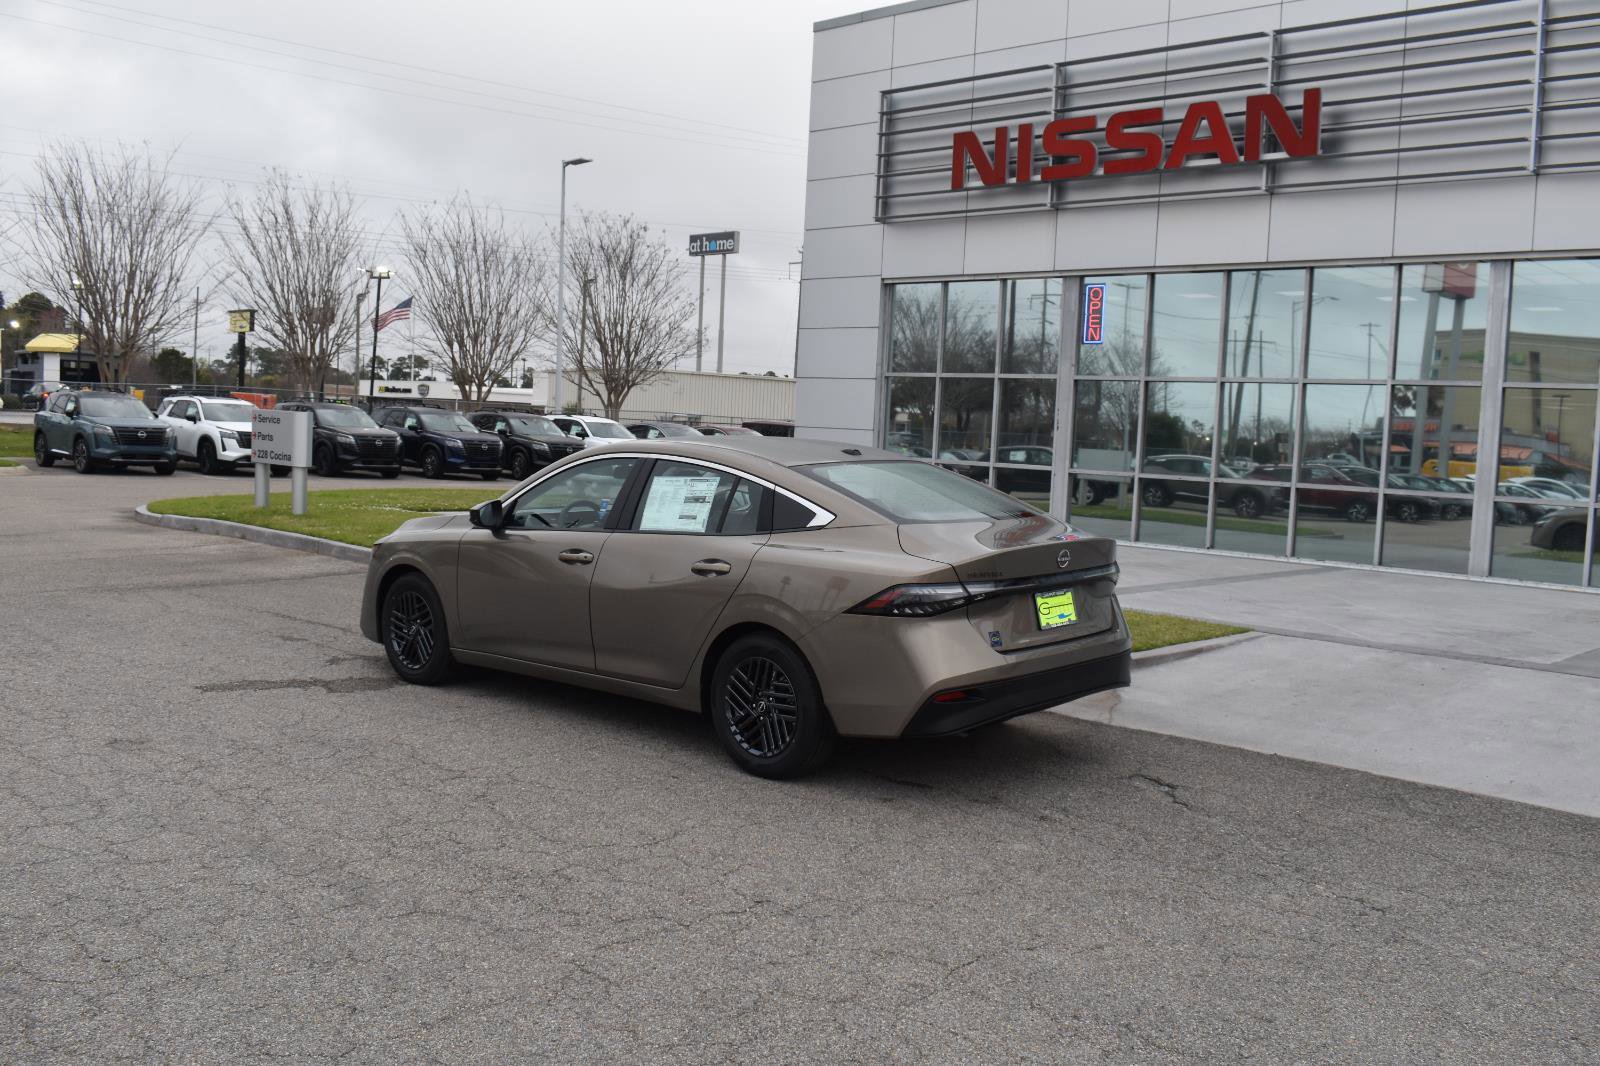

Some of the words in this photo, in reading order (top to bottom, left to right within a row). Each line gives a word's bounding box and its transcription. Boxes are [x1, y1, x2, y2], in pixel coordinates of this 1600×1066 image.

[951, 88, 1321, 191] NISSAN
[690, 240, 701, 252] at
[1088, 287, 1102, 341] OPEN
[257, 414, 281, 424] Service
[257, 431, 274, 442] Parts
[257, 449, 269, 459] 228
[270, 450, 292, 462] Cocina
